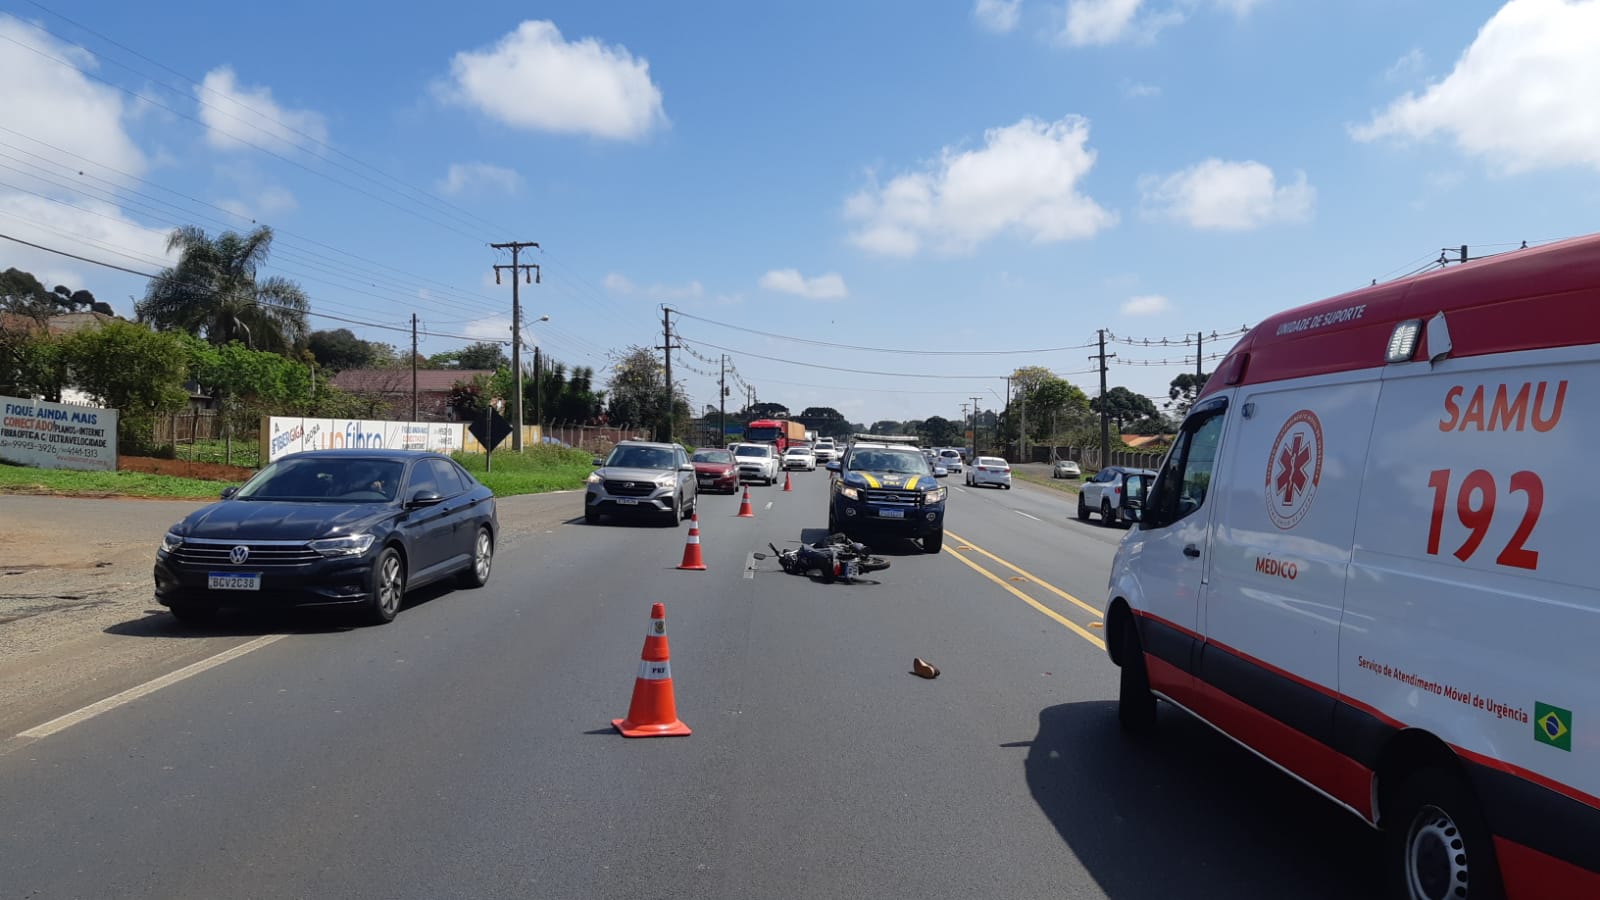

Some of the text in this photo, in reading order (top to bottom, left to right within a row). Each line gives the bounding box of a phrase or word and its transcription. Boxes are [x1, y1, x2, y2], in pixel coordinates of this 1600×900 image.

[1276, 304, 1368, 336] UNIDADE DE SUPORTE
[6, 403, 97, 425] FIQUE AINDA MAIS
[1438, 380, 1569, 432] SAMU
[272, 424, 305, 454] FIBERGIGA
[1427, 468, 1545, 570] 192
[1255, 551, 1298, 580] MÉDICO
[1358, 655, 1528, 723] Serviço de Atendimento Móvel de Urgência
